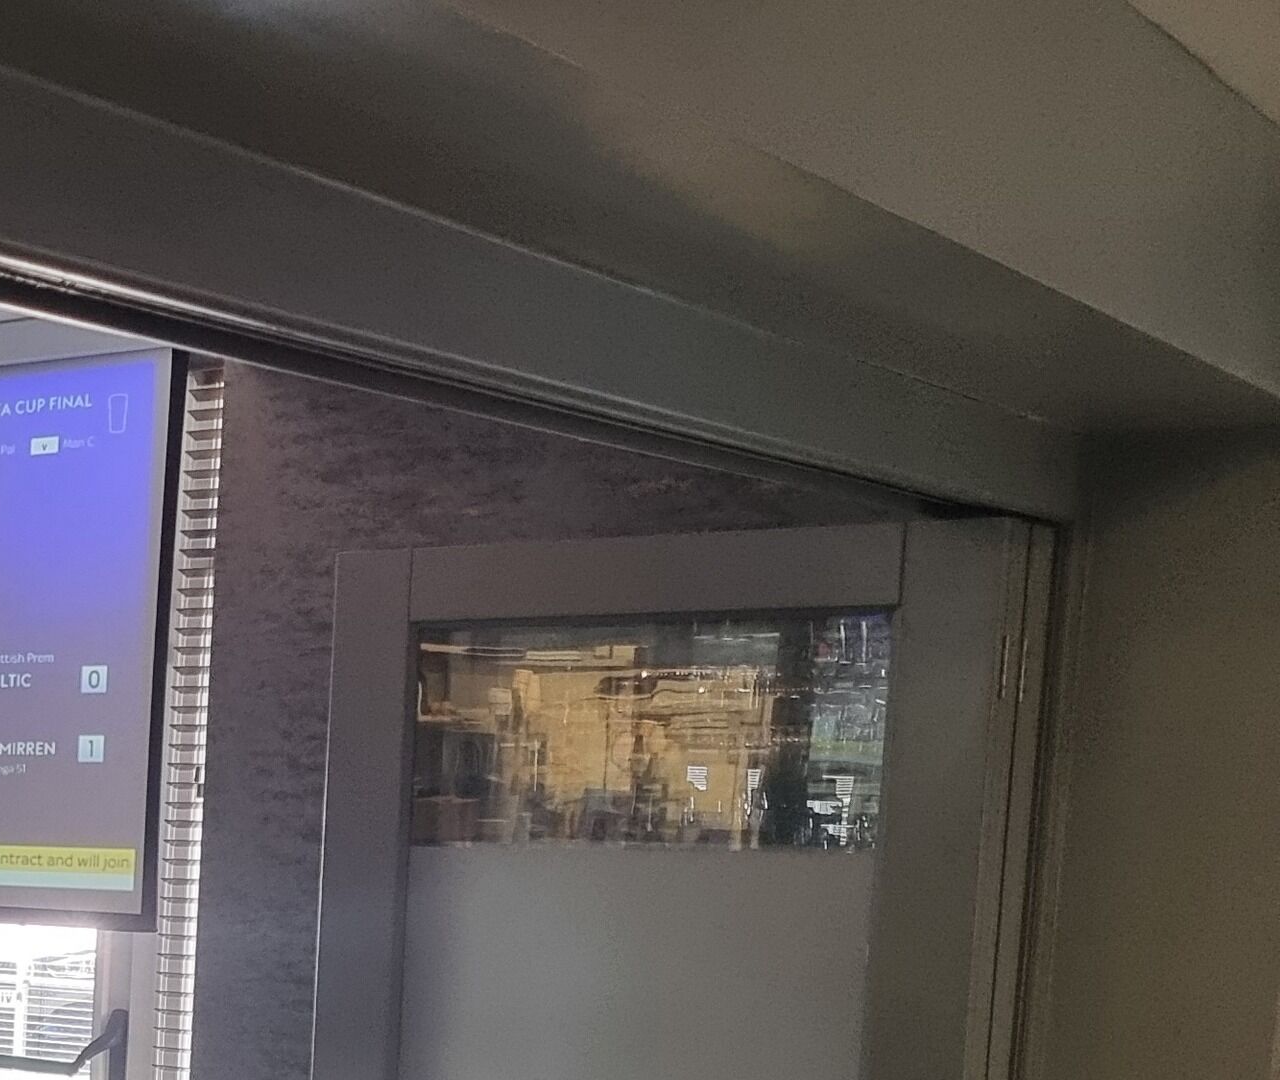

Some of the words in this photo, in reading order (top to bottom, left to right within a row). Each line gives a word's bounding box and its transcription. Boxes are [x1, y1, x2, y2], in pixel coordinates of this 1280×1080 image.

[15, 398, 46, 415] CUP
[49, 393, 92, 411] FINAL
[27, 652, 54, 664] Prem
[88, 670, 100, 688] 0
[88, 740, 94, 758] 1
[47, 854, 73, 868] and
[78, 855, 100, 868] will
[103, 857, 129, 871] join
